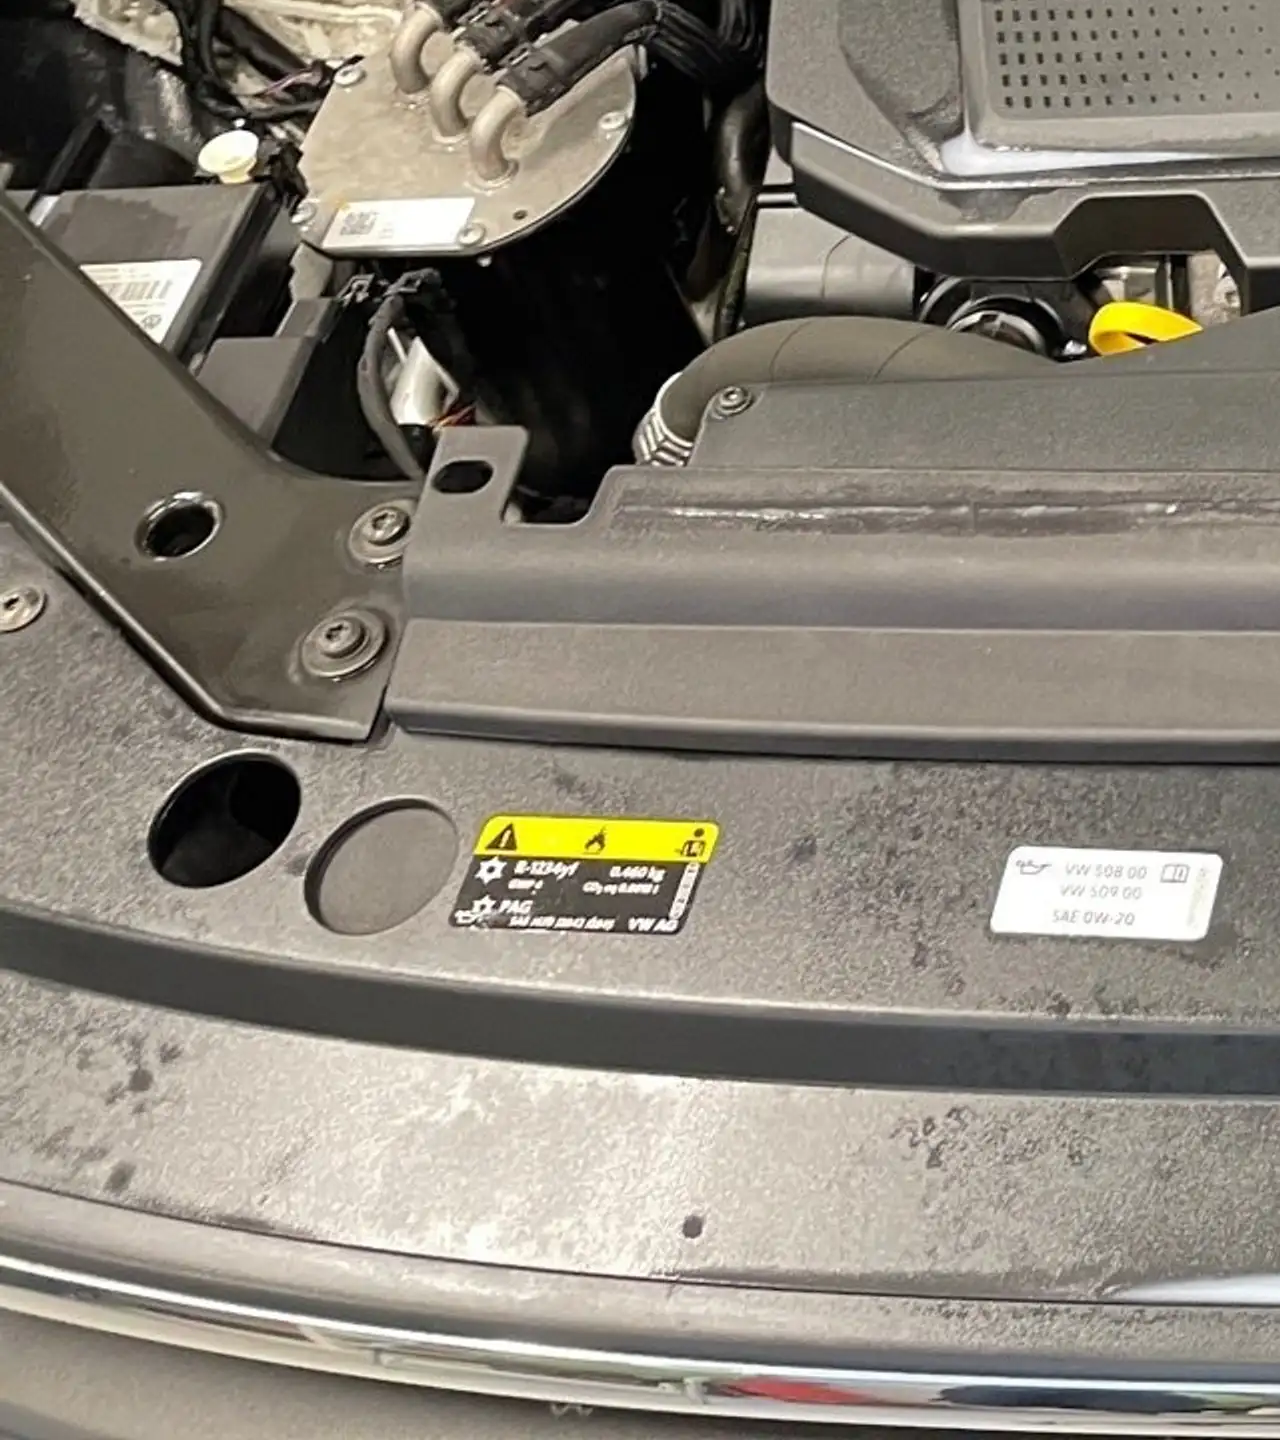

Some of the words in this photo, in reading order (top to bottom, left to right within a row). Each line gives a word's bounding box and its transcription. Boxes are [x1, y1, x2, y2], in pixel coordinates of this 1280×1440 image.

[1065, 863, 1091, 876] VW
[1095, 863, 1122, 879] 508
[1127, 865, 1148, 880] 00
[1060, 884, 1086, 897] VW
[1090, 884, 1119, 899] 509
[1122, 886, 1143, 900] 00
[499, 899, 534, 915] PAG
[628, 917, 653, 930] VW
[652, 918, 679, 932] AG
[1052, 909, 1081, 923] SAE
[1083, 911, 1136, 926] 0W-20
